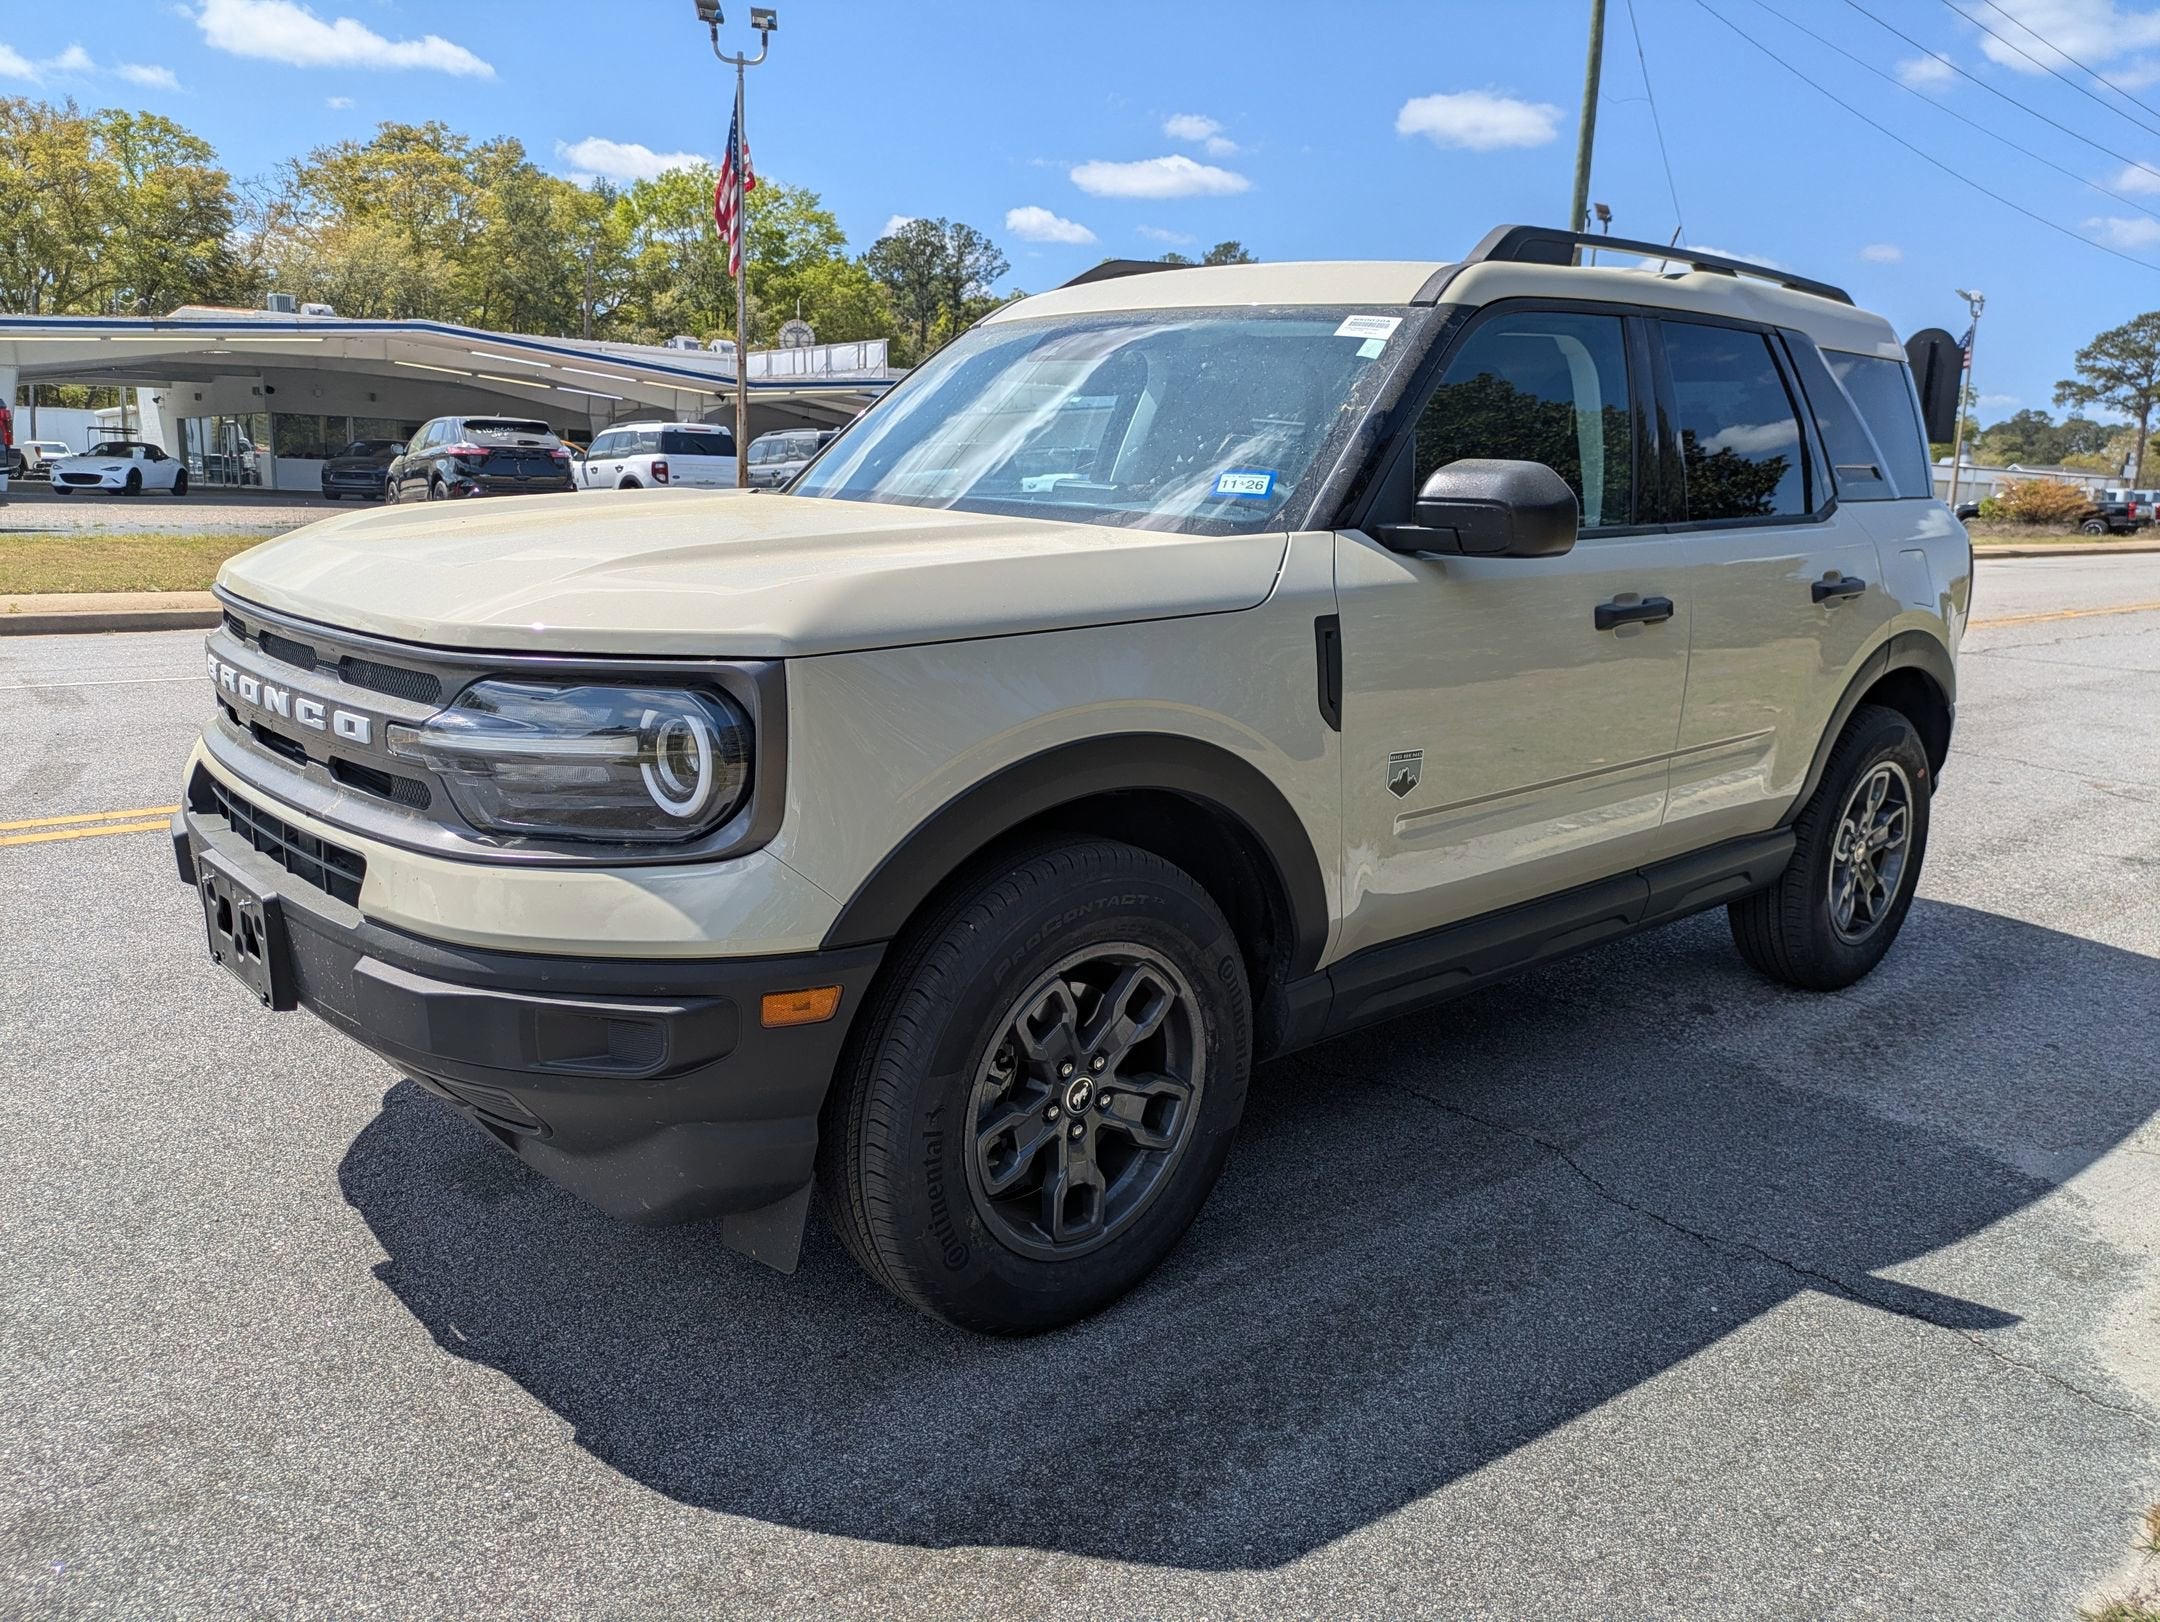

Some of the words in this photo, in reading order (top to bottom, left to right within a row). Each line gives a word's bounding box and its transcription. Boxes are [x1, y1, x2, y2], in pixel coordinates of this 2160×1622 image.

[1222, 479, 1238, 489] 11
[1244, 479, 1265, 490] 26
[207, 653, 372, 745] BRONCO
[921, 1130, 970, 1272] Continental
